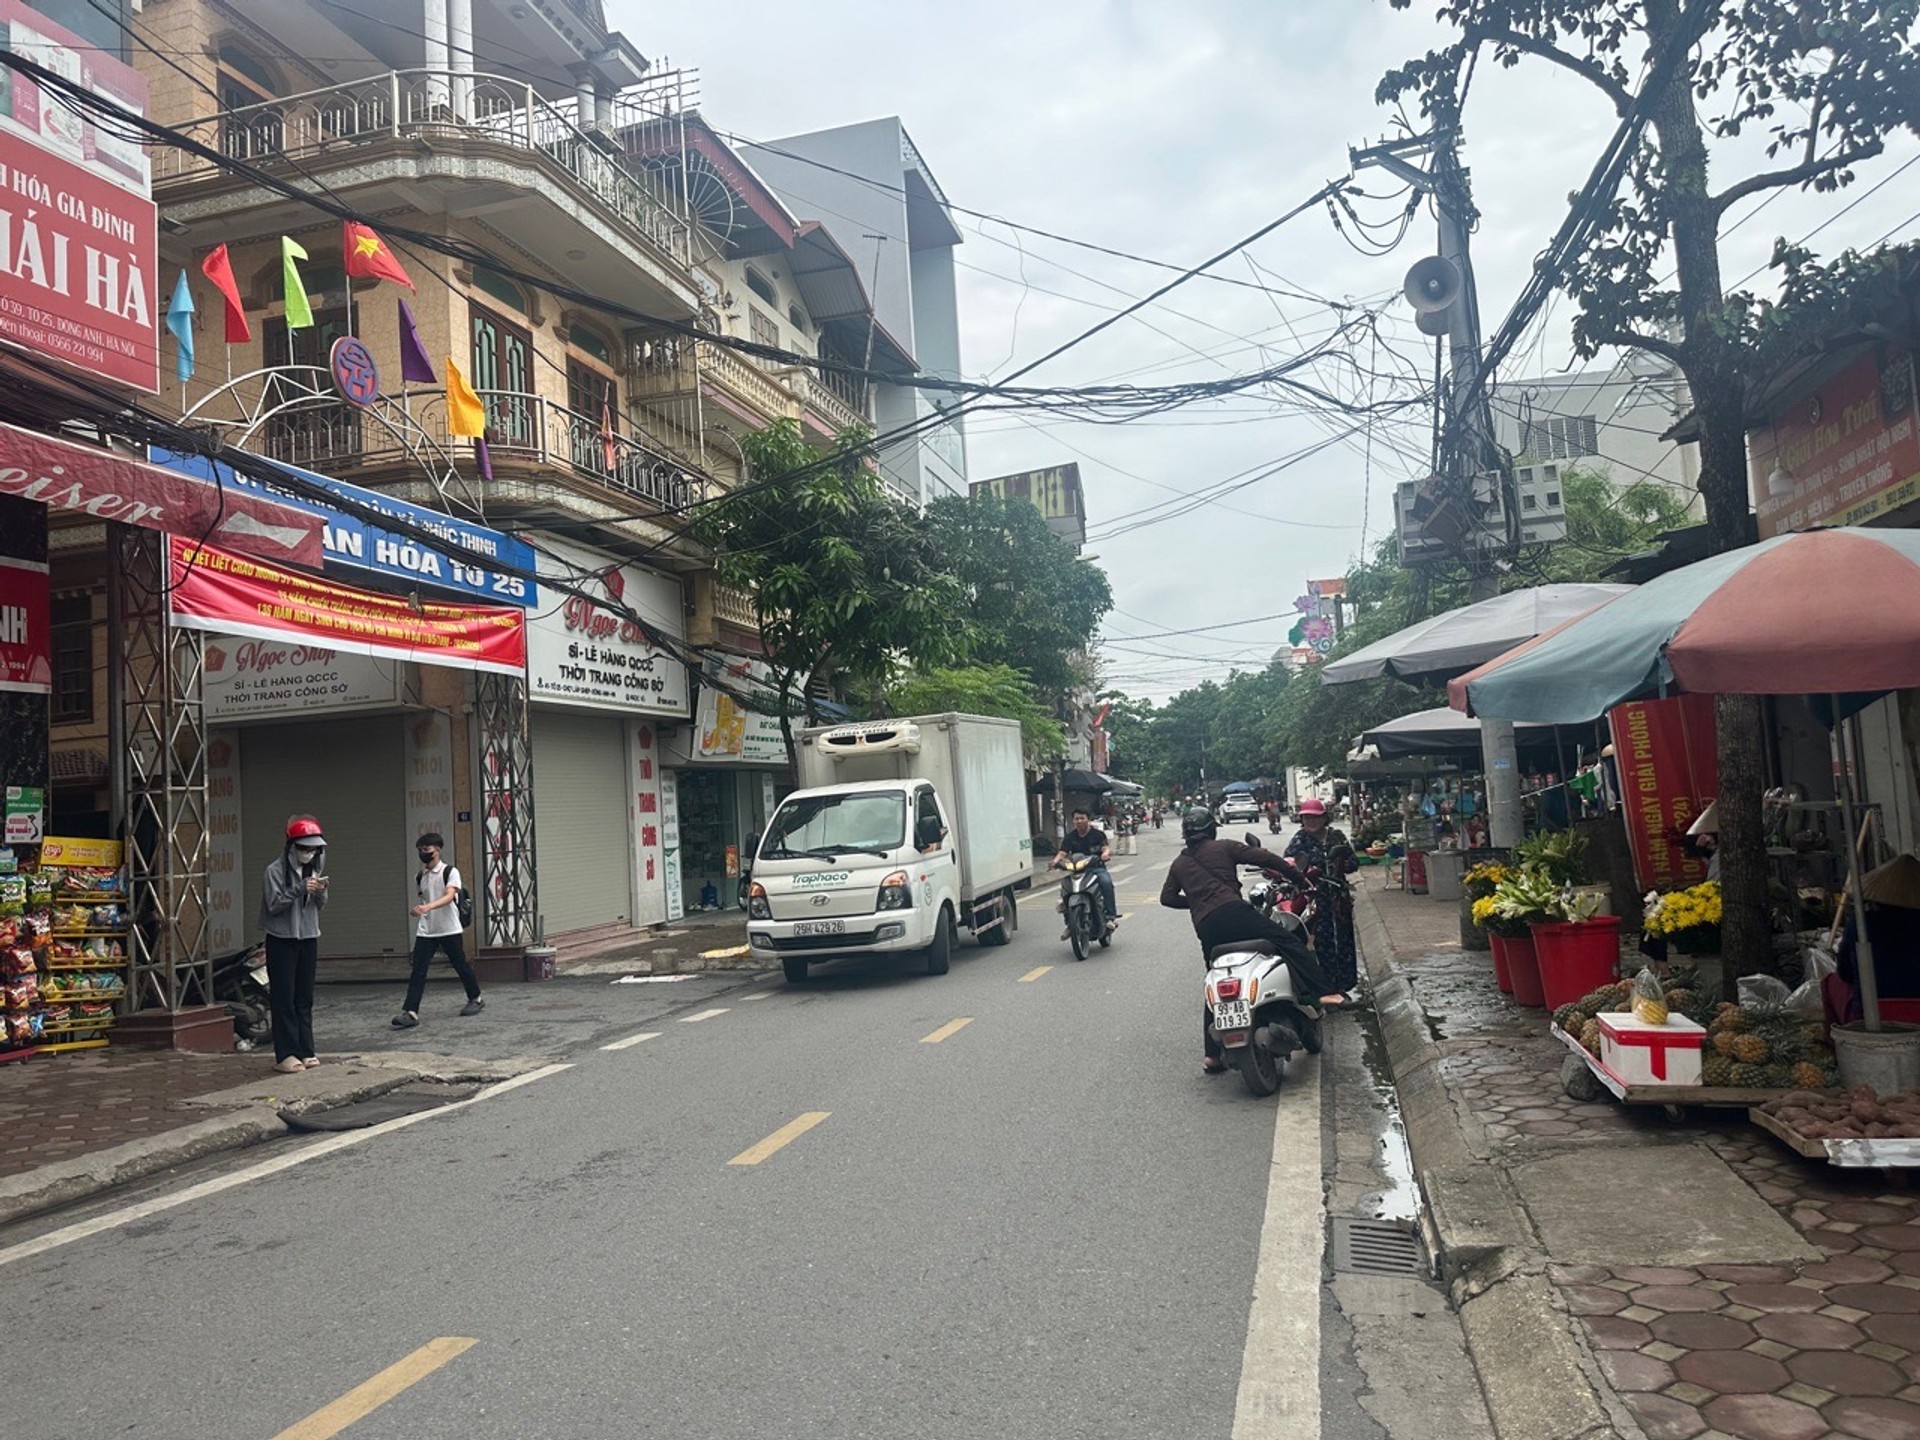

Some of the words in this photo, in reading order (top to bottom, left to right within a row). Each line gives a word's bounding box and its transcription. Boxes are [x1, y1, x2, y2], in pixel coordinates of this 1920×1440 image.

[13, 168, 53, 208] HÓA
[57, 191, 87, 224] GIA
[91, 205, 135, 245] ĐÌNH
[84, 244, 153, 329] HÀ
[211, 554, 230, 573] LIỆT
[231, 559, 254, 577] CHÀO
[376, 539, 441, 578] HÓA
[493, 573, 525, 598] 25
[273, 605, 293, 619] NĂM
[235, 640, 287, 673] Ngọc
[600, 648, 627, 668] HÀNG
[628, 656, 654, 672] QCCC
[270, 675, 302, 687] HÀNG
[305, 672, 338, 684] QCCC
[559, 663, 586, 680] THỜI
[588, 669, 622, 687] TRANG
[624, 673, 649, 692] CÔNG
[651, 677, 664, 692] SỞ
[224, 693, 250, 704] THỜI
[254, 690, 292, 701] TRANG
[295, 685, 328, 698] CÔNG
[1627, 710, 1653, 761] PHÓNG
[1629, 763, 1658, 792] GIẢI
[1639, 795, 1663, 838] NGÀY
[1647, 838, 1672, 873] NĂM
[792, 871, 849, 885] Traphaco
